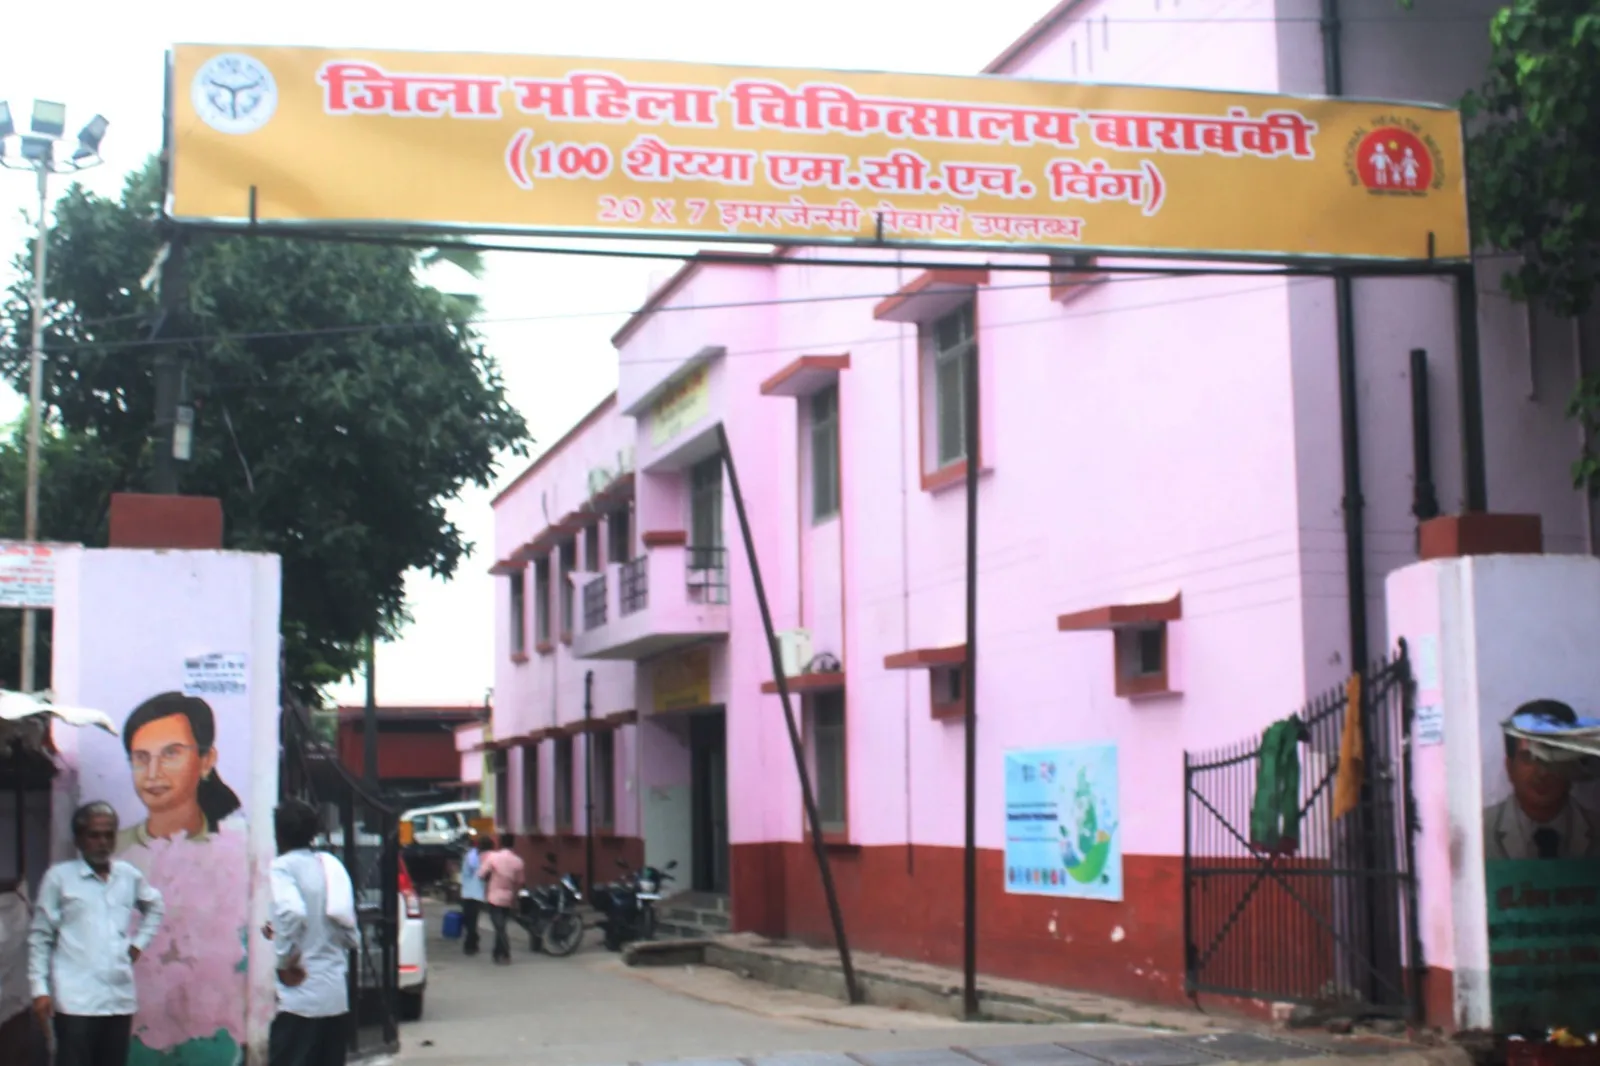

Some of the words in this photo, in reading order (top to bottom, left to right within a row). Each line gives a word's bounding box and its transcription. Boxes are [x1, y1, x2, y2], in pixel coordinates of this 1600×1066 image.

[321, 64, 502, 116] जिला
[514, 75, 719, 124] महिला
[732, 82, 1079, 144] चिकित्सालय
[1088, 109, 1315, 157] बाराबंकी
[510, 132, 608, 185] (100
[627, 137, 755, 182] शैय्या
[766, 152, 1033, 196] एम.सी.एच.
[1050, 160, 1161, 213] विंग)
[600, 197, 643, 221] 20
[687, 201, 708, 222] 7
[971, 214, 1085, 239] उपलब्ध
